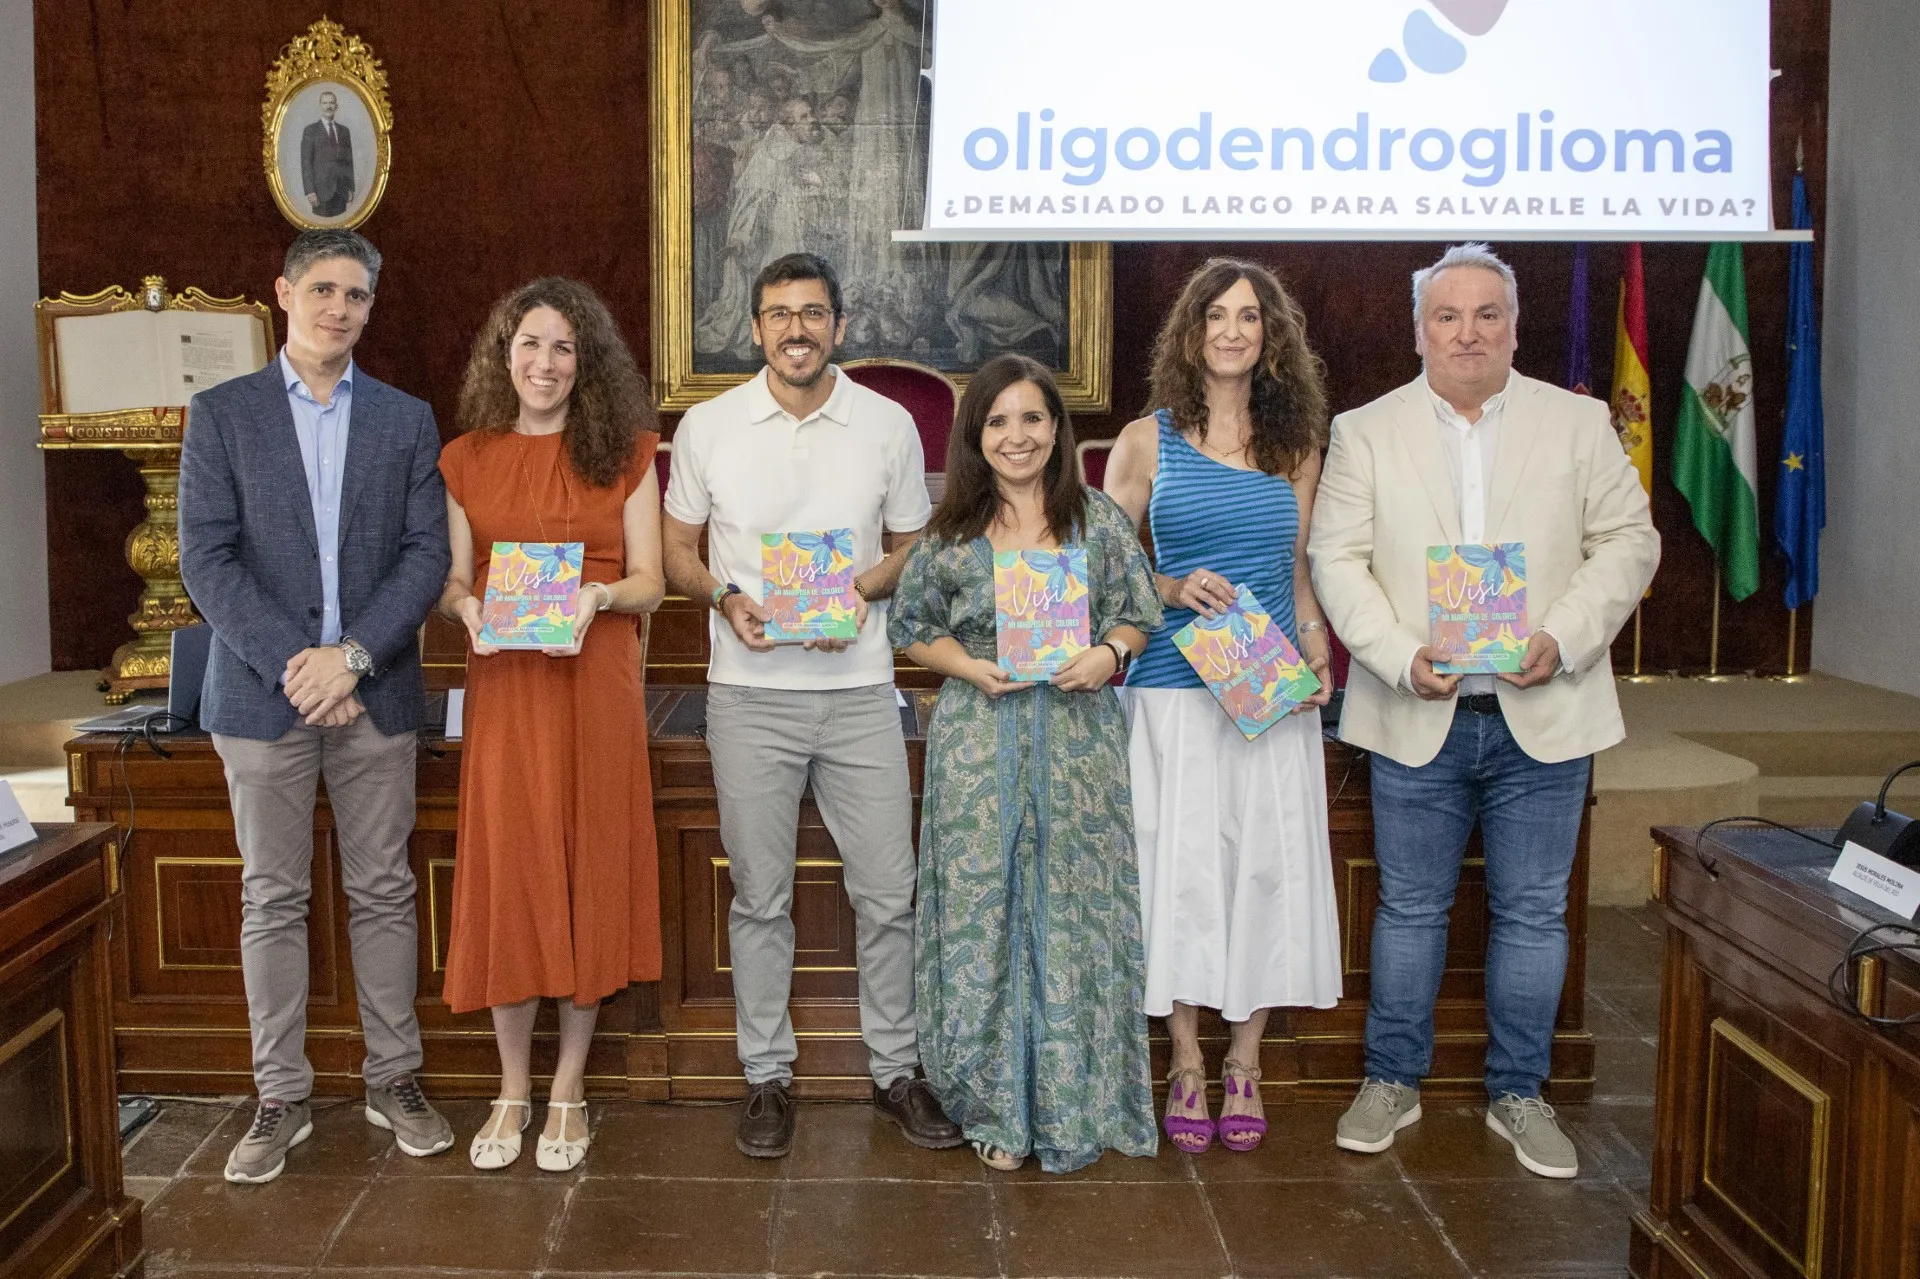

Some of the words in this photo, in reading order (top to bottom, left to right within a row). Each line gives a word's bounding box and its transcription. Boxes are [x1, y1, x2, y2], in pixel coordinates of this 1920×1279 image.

[964, 109, 1733, 186] oligodendroglioma
[945, 195, 1164, 217] ¿DEMASIADO
[1182, 196, 1291, 214] LARGO
[1311, 196, 1397, 214] PARA
[1415, 196, 1584, 215] SALVARLE
[1602, 197, 1641, 216] LA
[1657, 197, 1756, 217] VIDA?
[76, 426, 179, 438] CONSTITUCON
[504, 562, 560, 592] Visi
[779, 553, 833, 586] Visi
[1013, 576, 1068, 616] Visi
[1446, 571, 1504, 609] Visi
[1206, 627, 1255, 676] Visi
